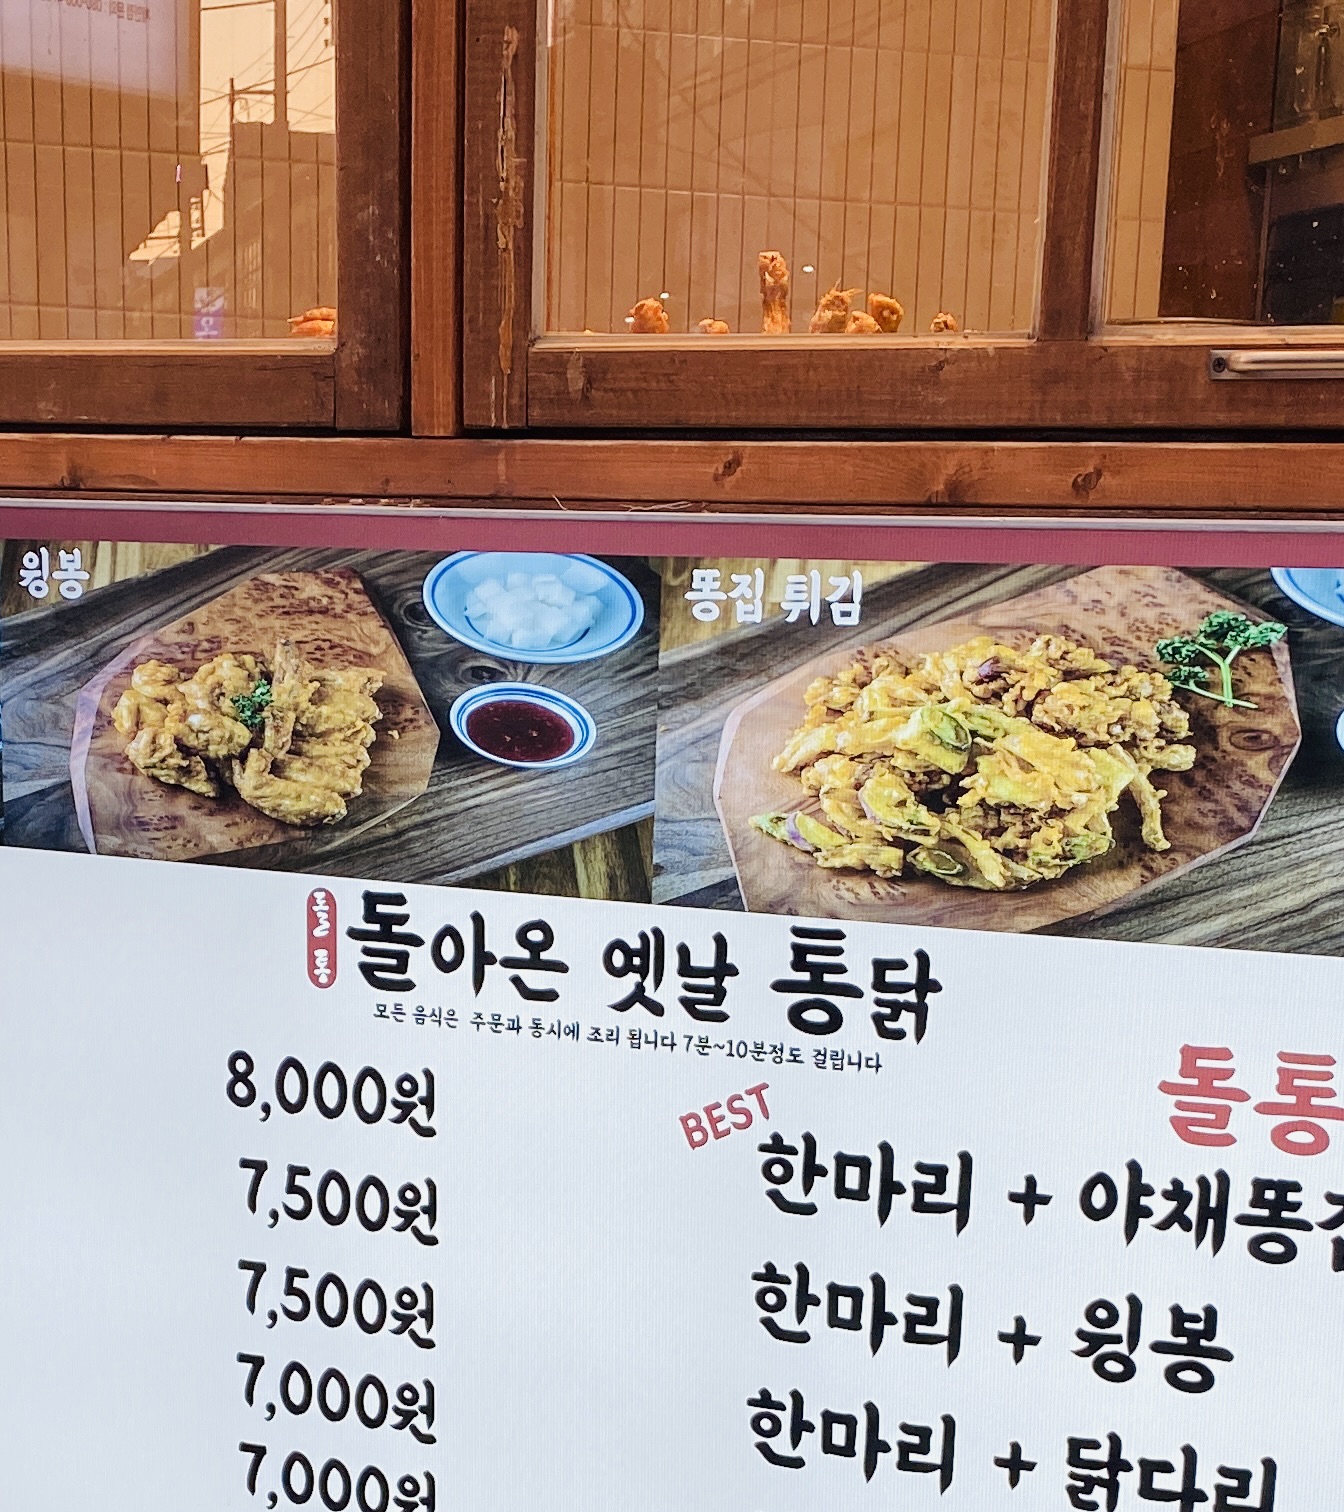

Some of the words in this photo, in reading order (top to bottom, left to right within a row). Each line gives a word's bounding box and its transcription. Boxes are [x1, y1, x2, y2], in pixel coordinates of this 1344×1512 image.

[19, 547, 90, 599] 윙봉
[684, 567, 765, 624] 똥집
[780, 569, 863, 626] 튀김
[346, 888, 570, 1002] 돌아온
[602, 926, 740, 1023] 옛날
[769, 924, 944, 1046] 통닭
[372, 1001, 407, 1024] 모든
[412, 1005, 460, 1030] 음식은
[469, 1011, 523, 1038] 주문과
[527, 1017, 582, 1043] 동시에
[587, 1023, 621, 1048] 조리
[626, 1027, 679, 1054] 됩니다
[810, 1047, 884, 1076] 걸립니다
[226, 1049, 438, 1138] 8,000원
[678, 1081, 775, 1151] BEST
[238, 1157, 440, 1247] 7,500원
[757, 1131, 975, 1236] 한마리
[1007, 1174, 1053, 1228] +
[236, 1258, 436, 1350] 7,500원
[750, 1260, 966, 1368] 한마리
[997, 1315, 1043, 1366] +
[1070, 1291, 1236, 1394] 윙봉
[236, 1351, 437, 1445] 7,000원
[745, 1387, 958, 1496] 한마리
[992, 1441, 1038, 1491] +
